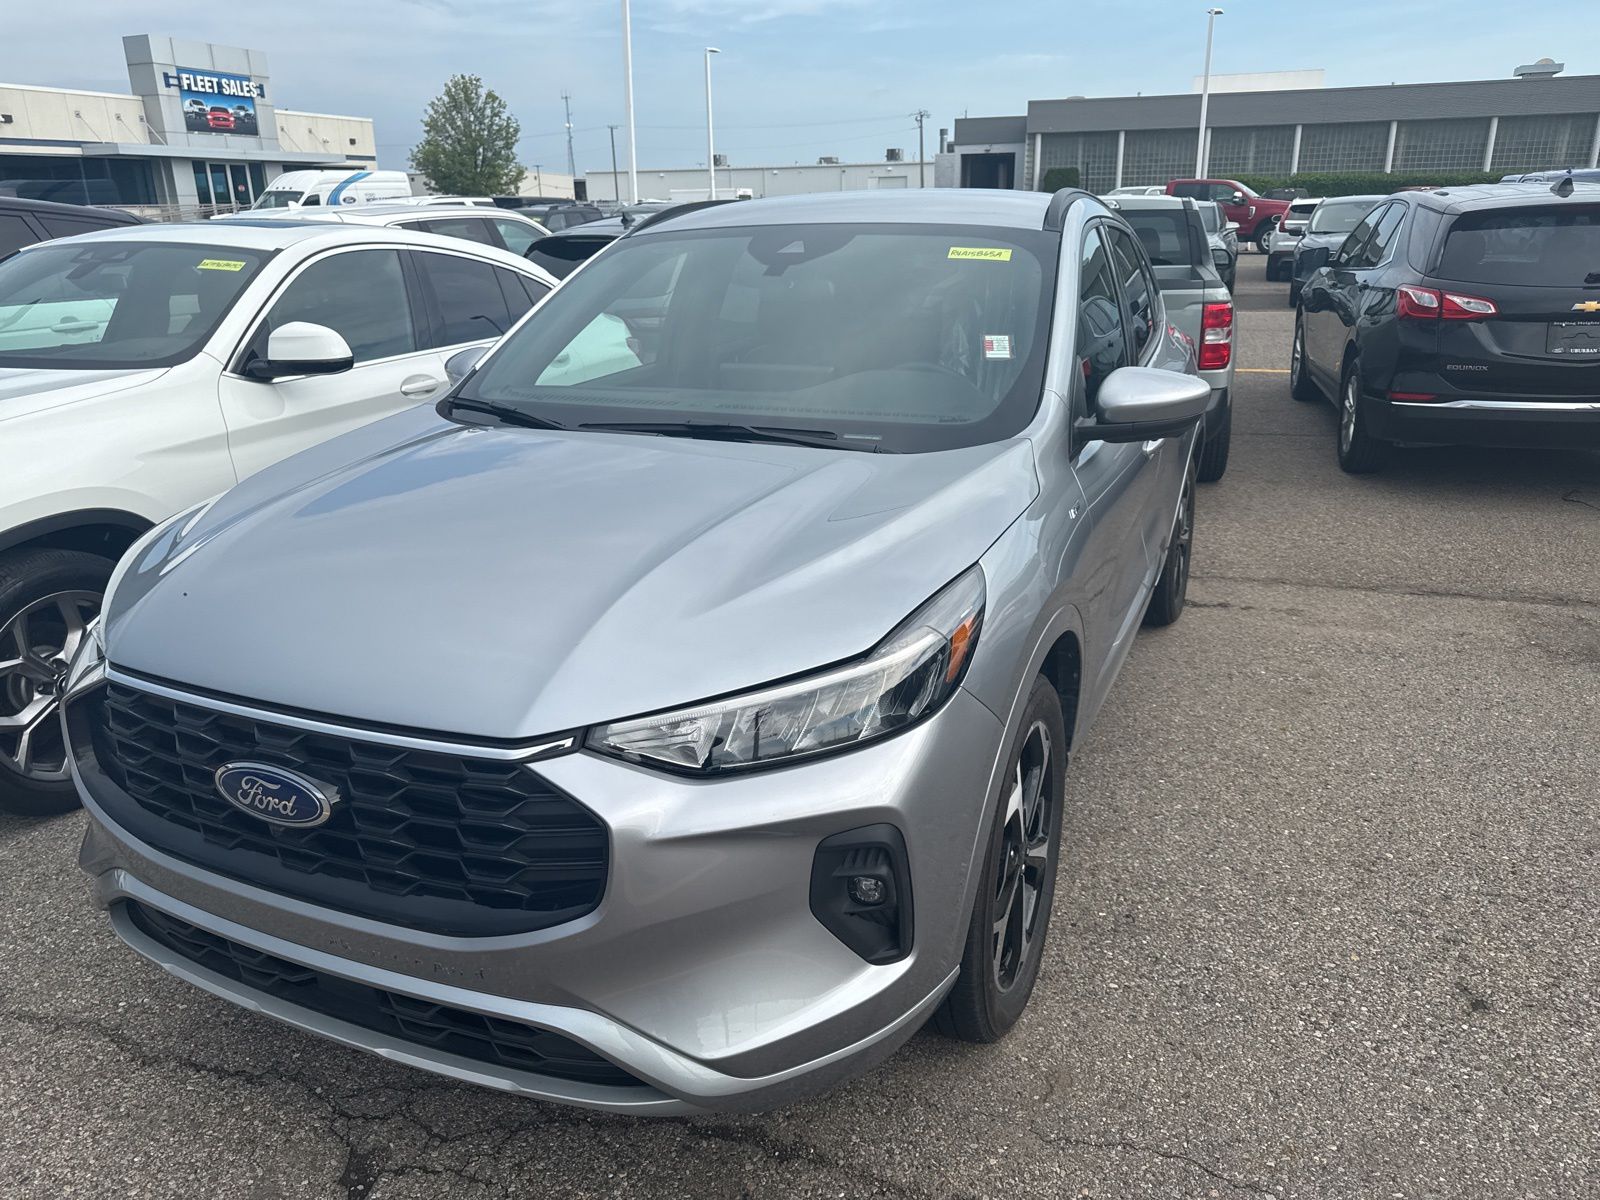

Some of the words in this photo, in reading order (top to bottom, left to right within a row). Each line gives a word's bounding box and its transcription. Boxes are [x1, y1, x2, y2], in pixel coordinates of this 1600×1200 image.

[182, 73, 218, 94] FLEET
[222, 78, 257, 98] SALES
[237, 775, 297, 816] Ford
